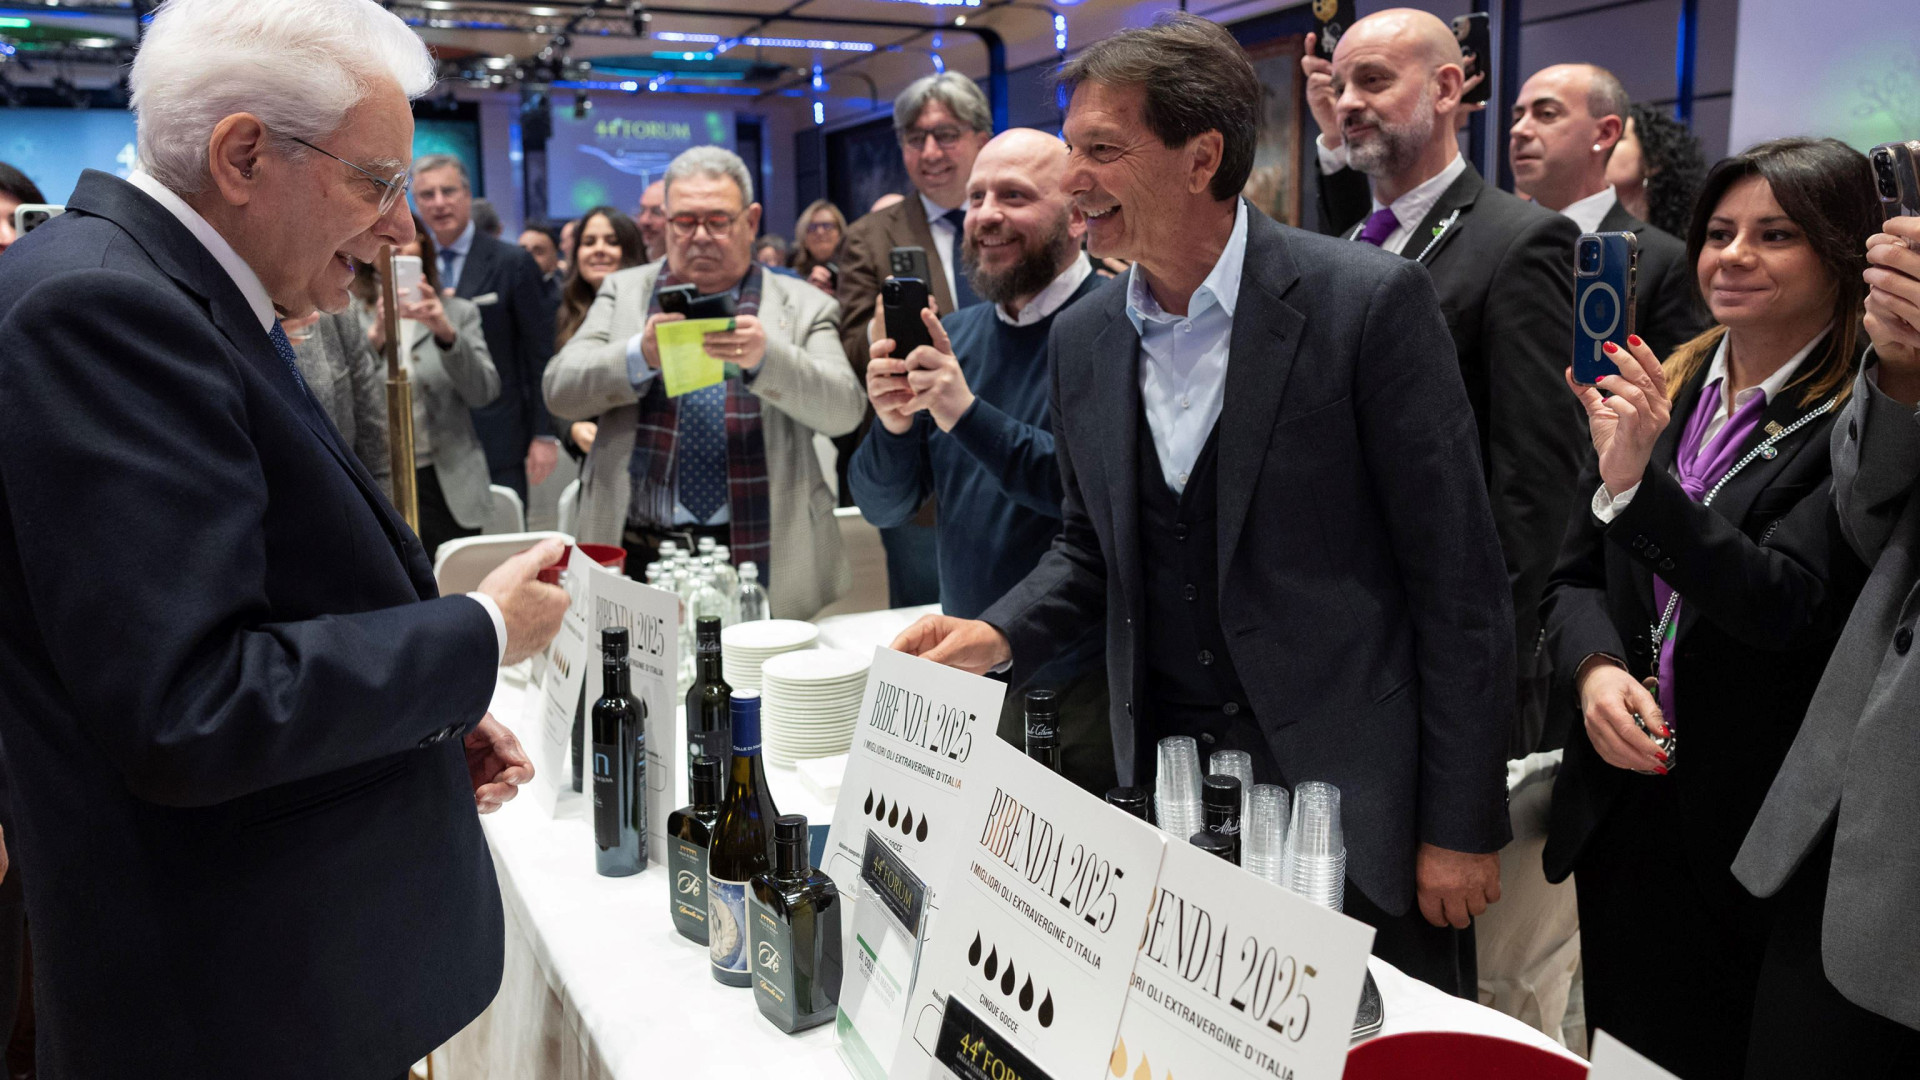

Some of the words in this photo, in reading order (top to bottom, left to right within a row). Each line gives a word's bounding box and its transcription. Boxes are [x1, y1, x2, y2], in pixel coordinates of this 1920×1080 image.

[636, 612, 665, 657] 2025
[869, 680, 933, 749] BIBENDA
[929, 704, 977, 763] 2025
[867, 741, 887, 757] MIGLIORI
[886, 749, 895, 762] OLI
[894, 753, 936, 779] EXTRAVERGINE
[935, 770, 962, 789] D'ITALIA
[884, 865, 913, 909] FORUM
[979, 786, 1065, 899] BIBENDA
[1059, 843, 1125, 934] 2025
[969, 860, 975, 871] I
[973, 867, 1000, 894] MIGLIORI
[1000, 885, 1013, 903] OLI
[1012, 894, 1069, 944] EXTRAVERGINE
[1066, 935, 1102, 970] D'ITALIA
[979, 993, 999, 1018] CINQUE
[999, 1010, 1020, 1034] GOCCE
[1230, 935, 1317, 1042] 2025
[1146, 984, 1163, 1004] OLI
[1164, 995, 1243, 1054] EXTRAVERGINE
[1244, 1044, 1296, 1080] D'ITALIA
